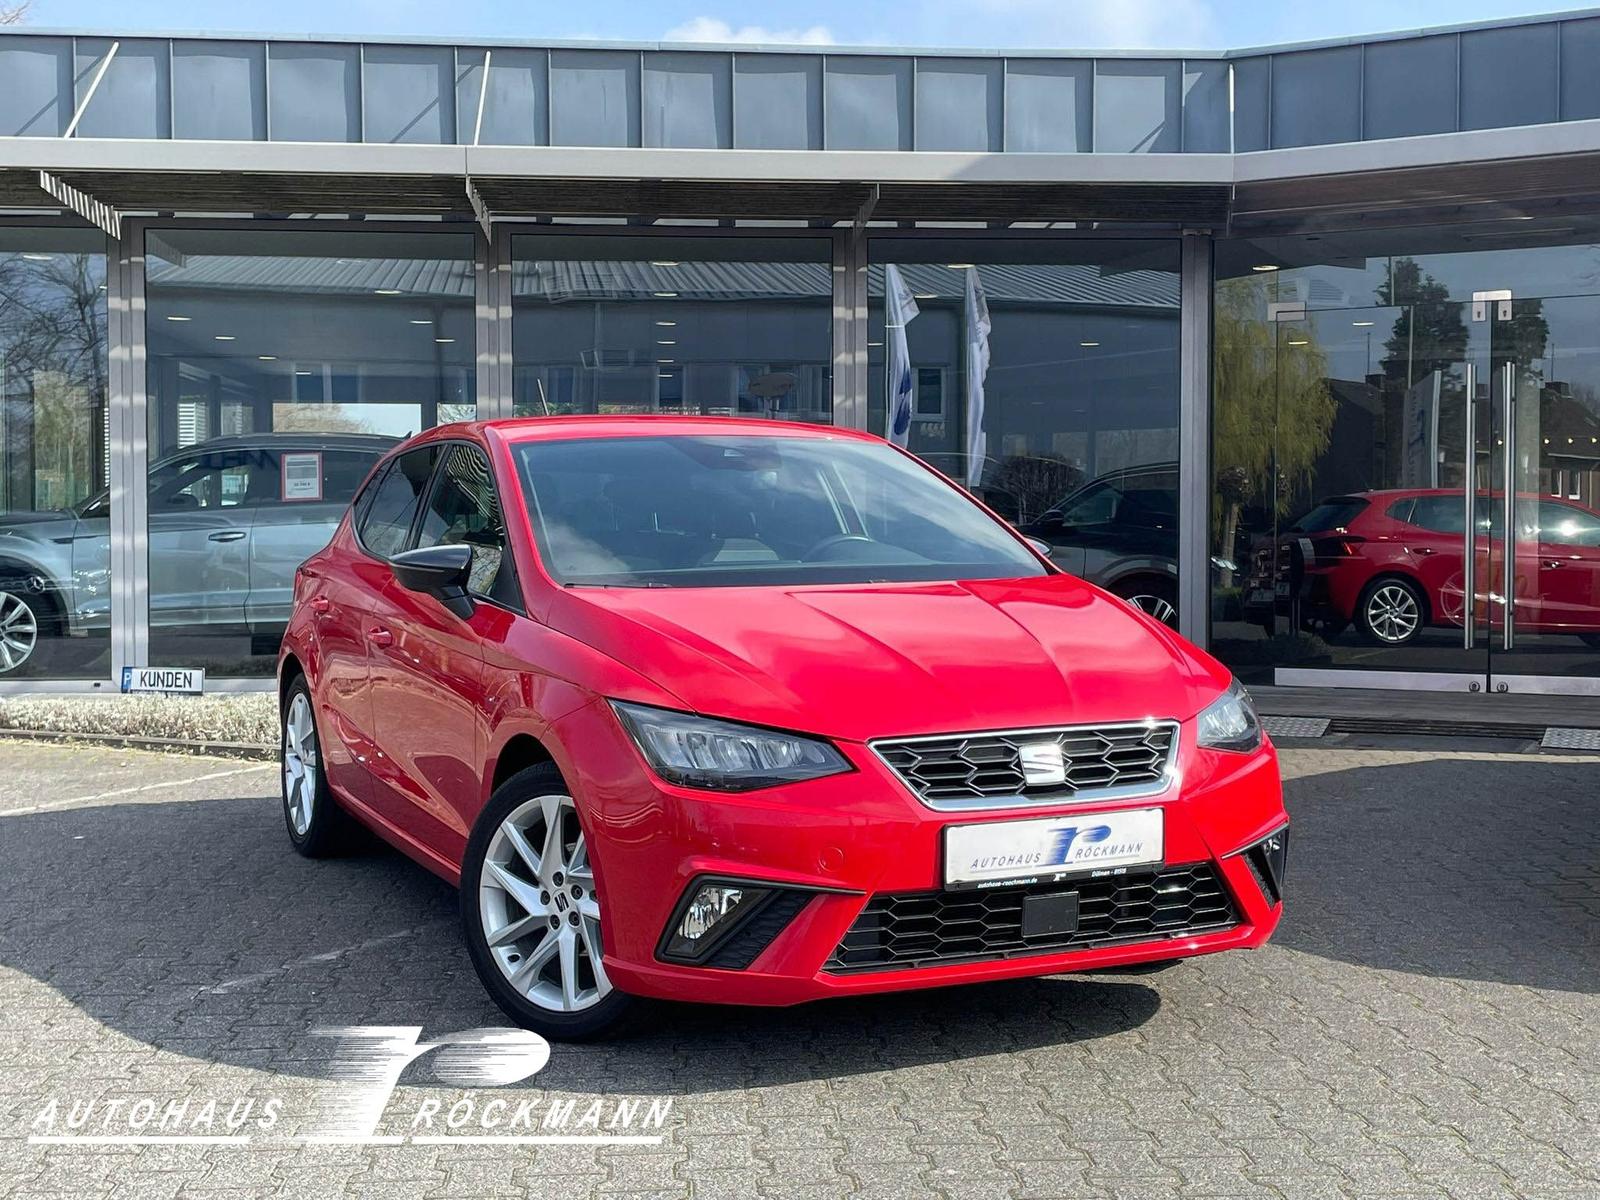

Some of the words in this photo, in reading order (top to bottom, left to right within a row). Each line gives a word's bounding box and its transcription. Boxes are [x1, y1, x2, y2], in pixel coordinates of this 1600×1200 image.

[124, 672, 132, 685] P
[139, 670, 193, 688] KUNDEN
[970, 852, 1042, 869] AUTOHAUS
